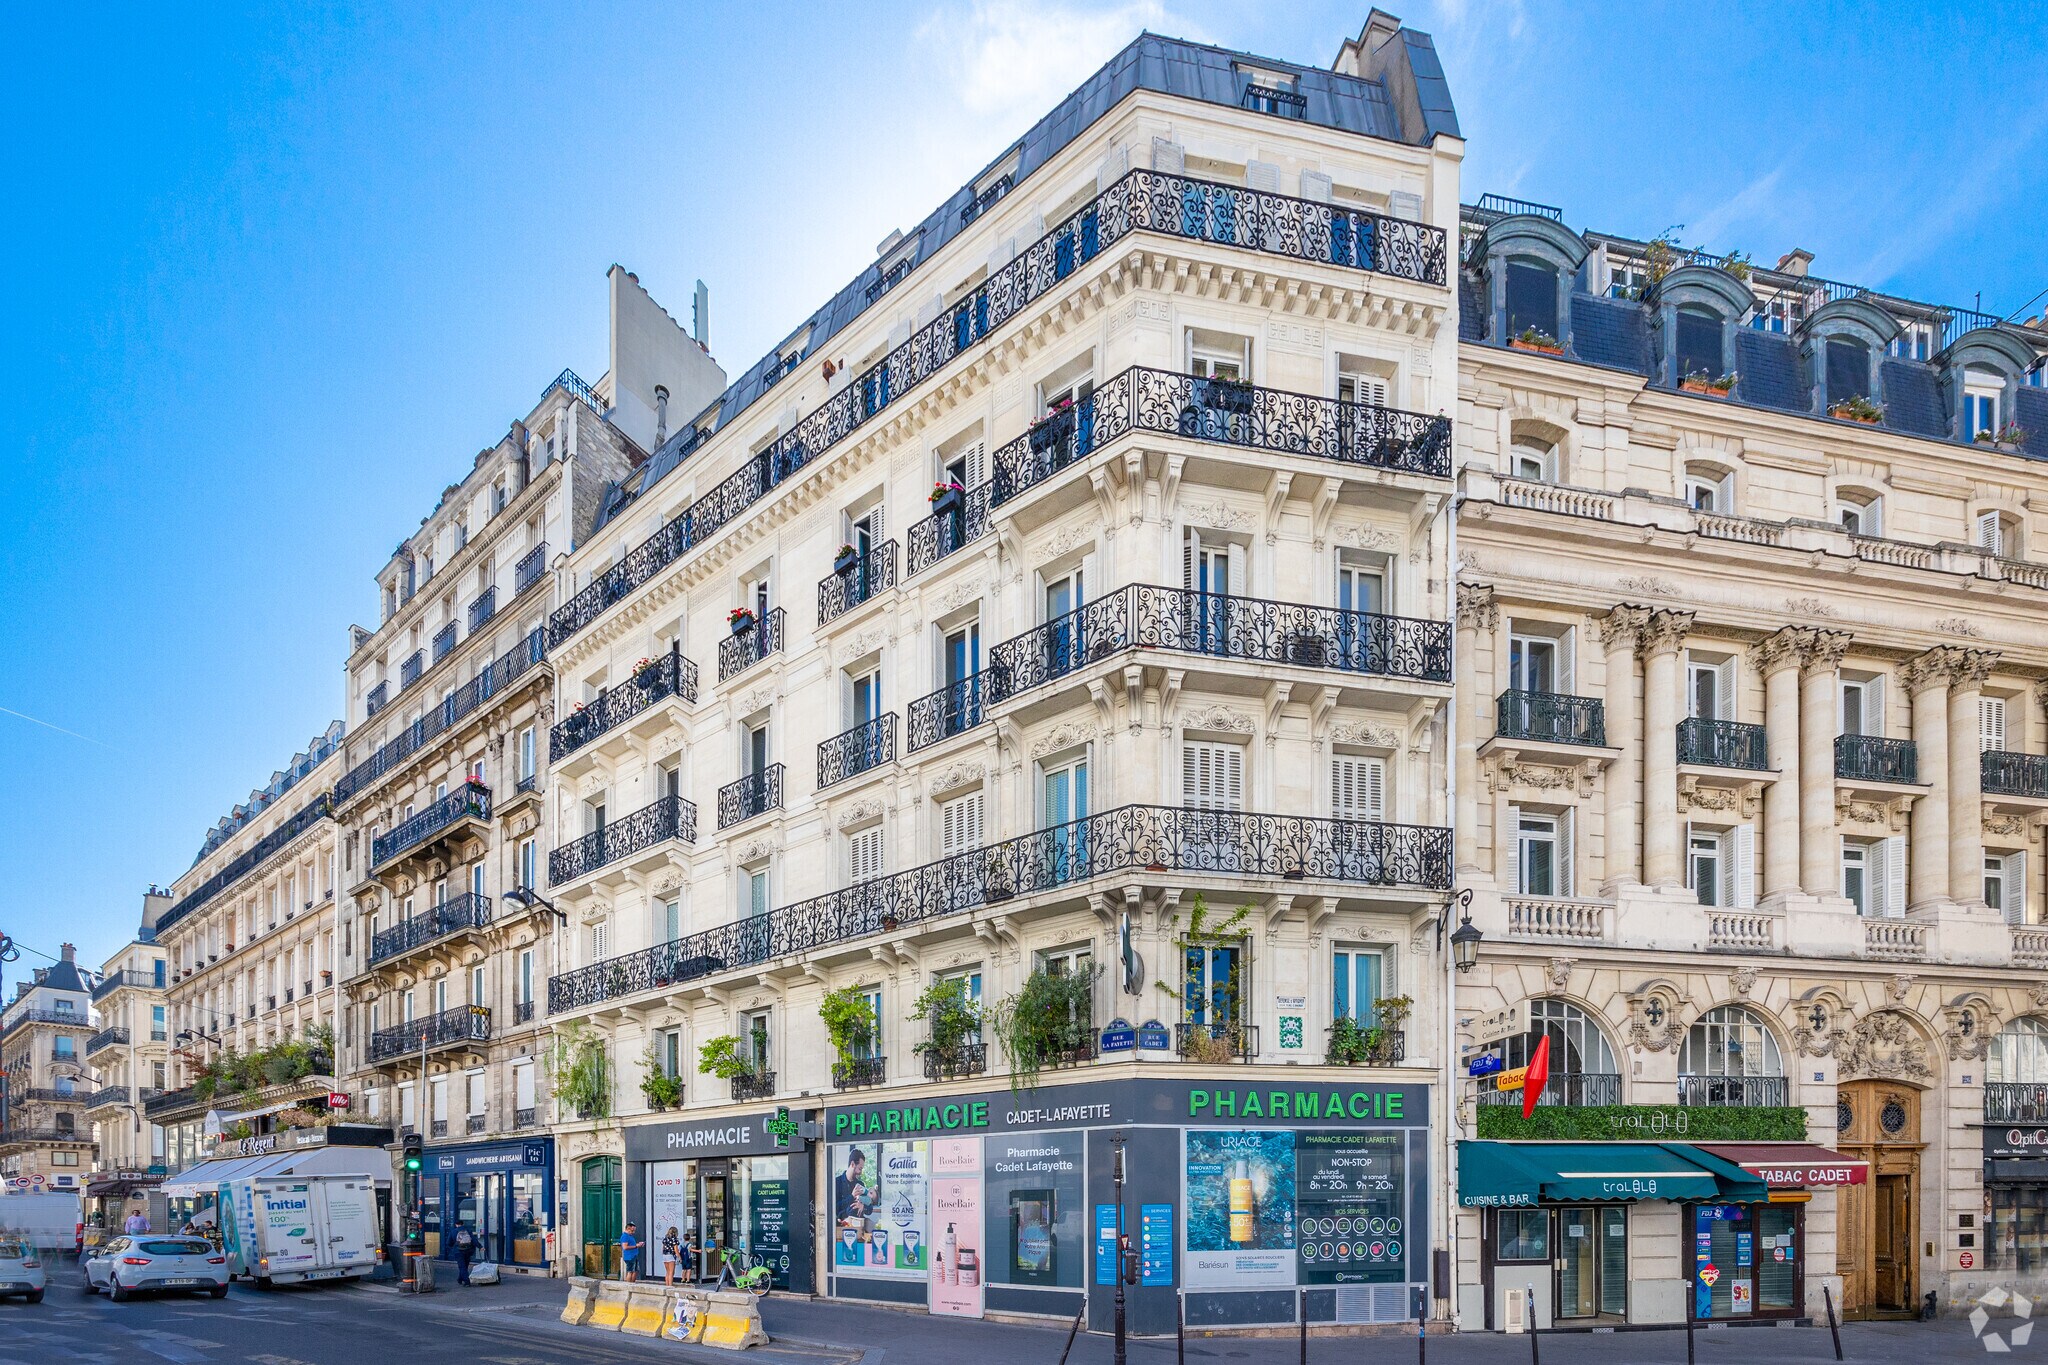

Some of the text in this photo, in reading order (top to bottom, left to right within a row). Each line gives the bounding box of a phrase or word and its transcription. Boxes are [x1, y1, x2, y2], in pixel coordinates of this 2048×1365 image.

[1472, 1059, 1483, 1068] FDJ
[1498, 1073, 1524, 1085] Tabac
[332, 1095, 348, 1105] illy
[1189, 1090, 1404, 1120] PHARMACIE
[836, 1101, 989, 1136] PHARMACIE
[667, 1127, 750, 1148] PHARMACIE
[1220, 1137, 1262, 1149] URIAGE
[238, 1139, 246, 1154] Le
[1007, 1146, 1060, 1157] Pharmacie
[466, 1156, 498, 1165] SANDWICHERIE
[889, 1158, 917, 1170] Gallia
[939, 1156, 975, 1165] RoseBaie
[996, 1161, 1073, 1172] Cadet Lafayette
[1759, 1169, 1852, 1182] TABAC CADET
[1310, 1181, 1320, 1190] 8h
[1329, 1181, 1347, 1190] 20h
[1356, 1181, 1366, 1190] 9h
[1376, 1181, 1393, 1190] 20h
[267, 1199, 306, 1210] Initial
[938, 1199, 975, 1208] RoseBaie
[1464, 1194, 1529, 1205] CUISINE & BAR
